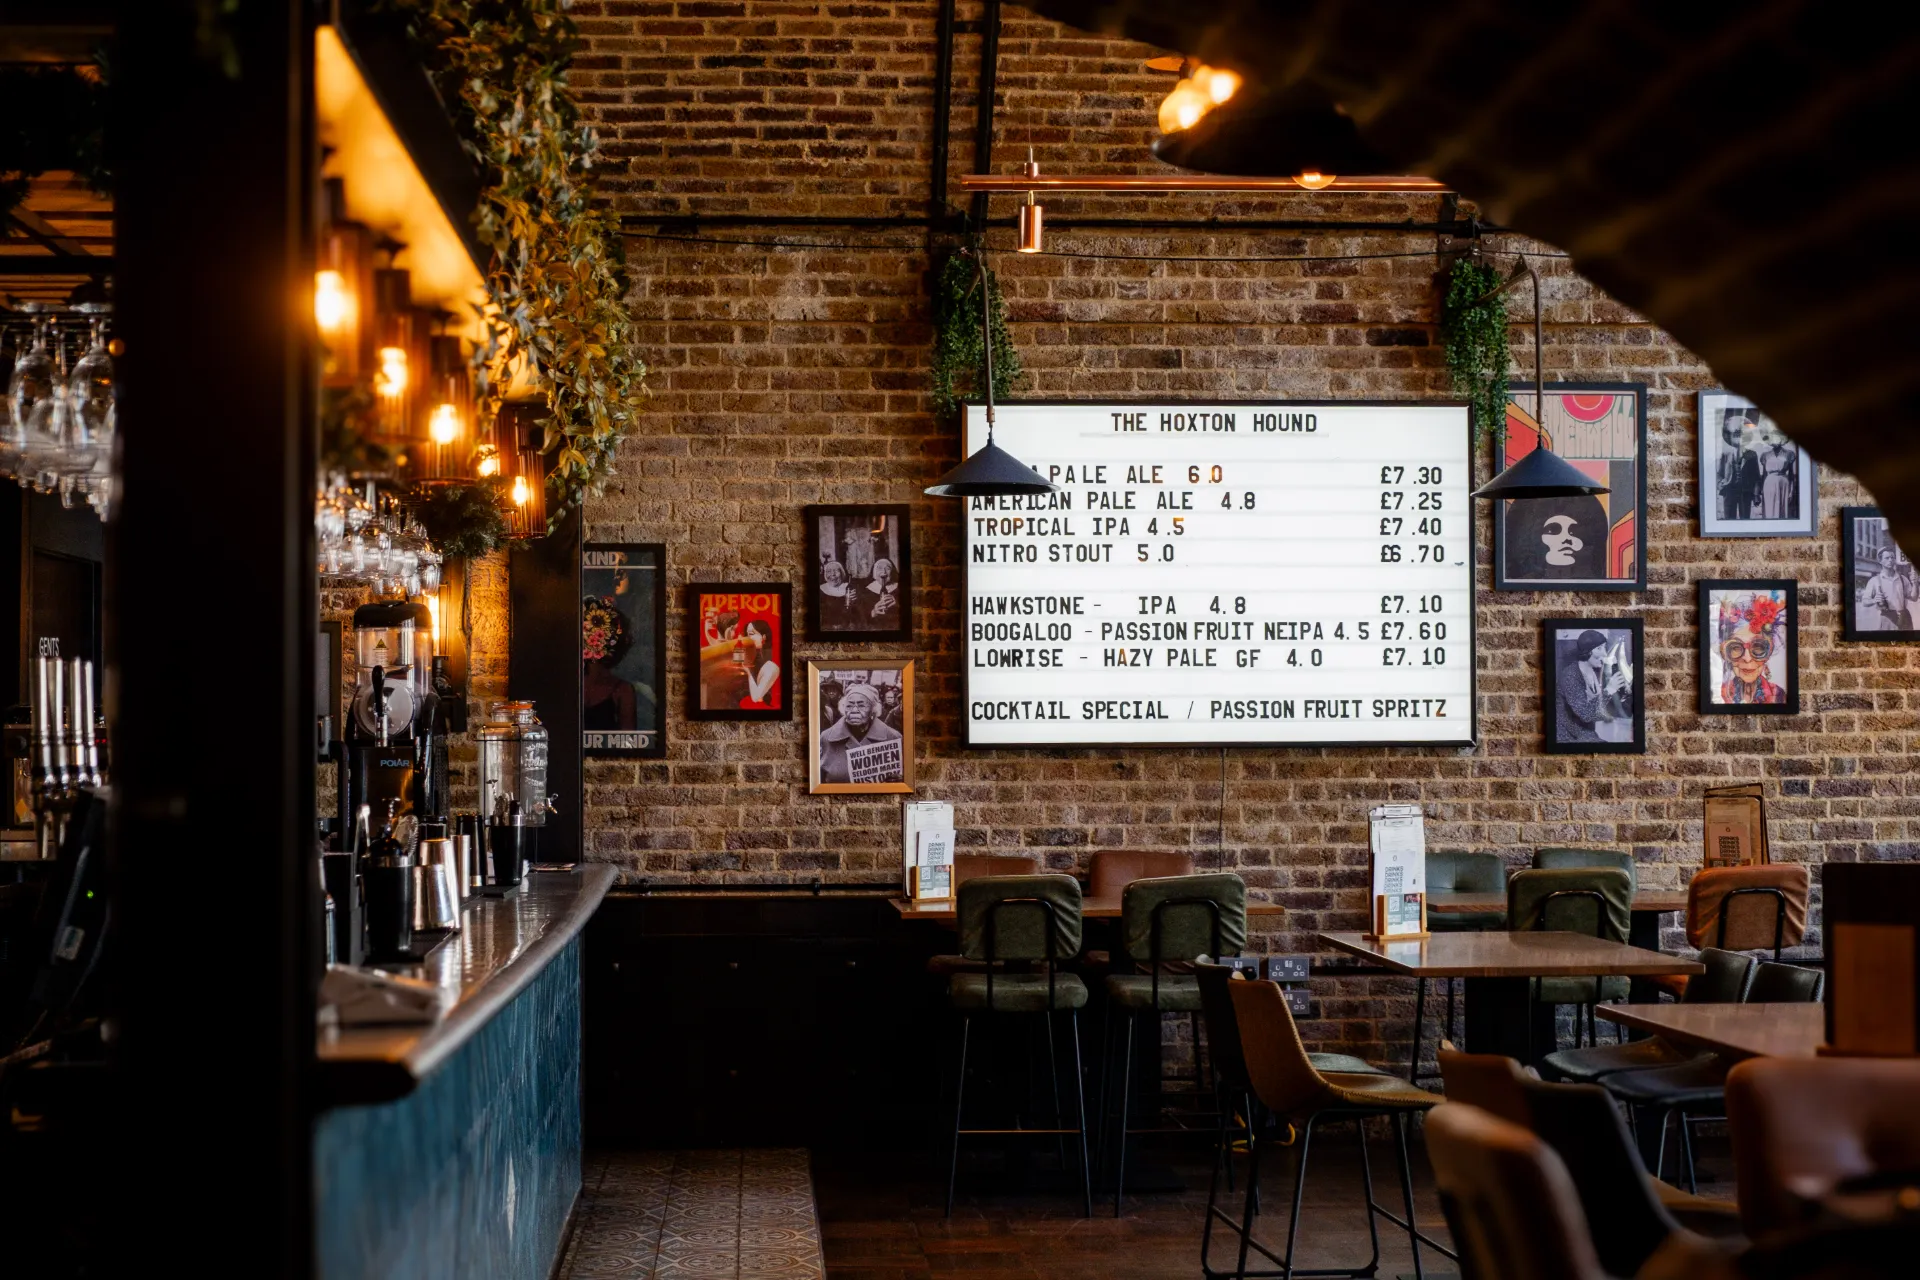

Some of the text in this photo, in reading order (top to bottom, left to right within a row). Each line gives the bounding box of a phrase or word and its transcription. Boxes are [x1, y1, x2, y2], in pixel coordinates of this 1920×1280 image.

[1110, 413, 1317, 433] THE HOXTON HOUND
[1049, 465, 1107, 484] PALE
[1126, 465, 1164, 484] ALE
[1188, 465, 1223, 484] 6.0
[1380, 466, 1443, 485] £7.30
[971, 491, 1256, 511] AMERICAN PALE ALE 4.8
[1380, 491, 1443, 511] £7.25
[973, 517, 1185, 537] TROPICAL IPA 4.5
[1379, 517, 1442, 536] £7.40
[582, 551, 620, 566] KIND
[972, 543, 1174, 563] NITRO STOUT 5.0
[1380, 544, 1445, 563] £6.70
[972, 596, 1085, 616] HAWKSTONE
[1138, 595, 1177, 615] IPA
[1209, 595, 1246, 615] 4.8
[1380, 594, 1443, 614] £7.10
[971, 622, 1072, 642] BOOGALOO
[1101, 621, 1188, 641] PASSION
[1194, 621, 1254, 641] FRUIT
[1264, 621, 1324, 641] NEIPA
[1333, 621, 1370, 641] 4.5
[1380, 621, 1447, 641] £7.60
[38, 636, 60, 657] GENTS
[1382, 647, 1446, 666] £7.10
[974, 648, 1064, 668] LOWRISE
[1103, 648, 1153, 667] HAZY
[1167, 648, 1217, 667] PALE
[1236, 648, 1261, 668] GF
[1286, 648, 1323, 667] 4.0
[971, 700, 1071, 721] COCKTAIL
[1082, 700, 1169, 720] SPECIAL
[1210, 700, 1295, 720] PASSION
[1304, 699, 1363, 719] FRUIT
[1372, 698, 1447, 718] SPRITZ
[583, 734, 650, 749] UR MIND
[850, 742, 899, 759] WELL BEHAVED
[380, 758, 410, 768] POLAR
[850, 750, 900, 771] WOMEN
[852, 763, 901, 778] SELDOM MAKE
